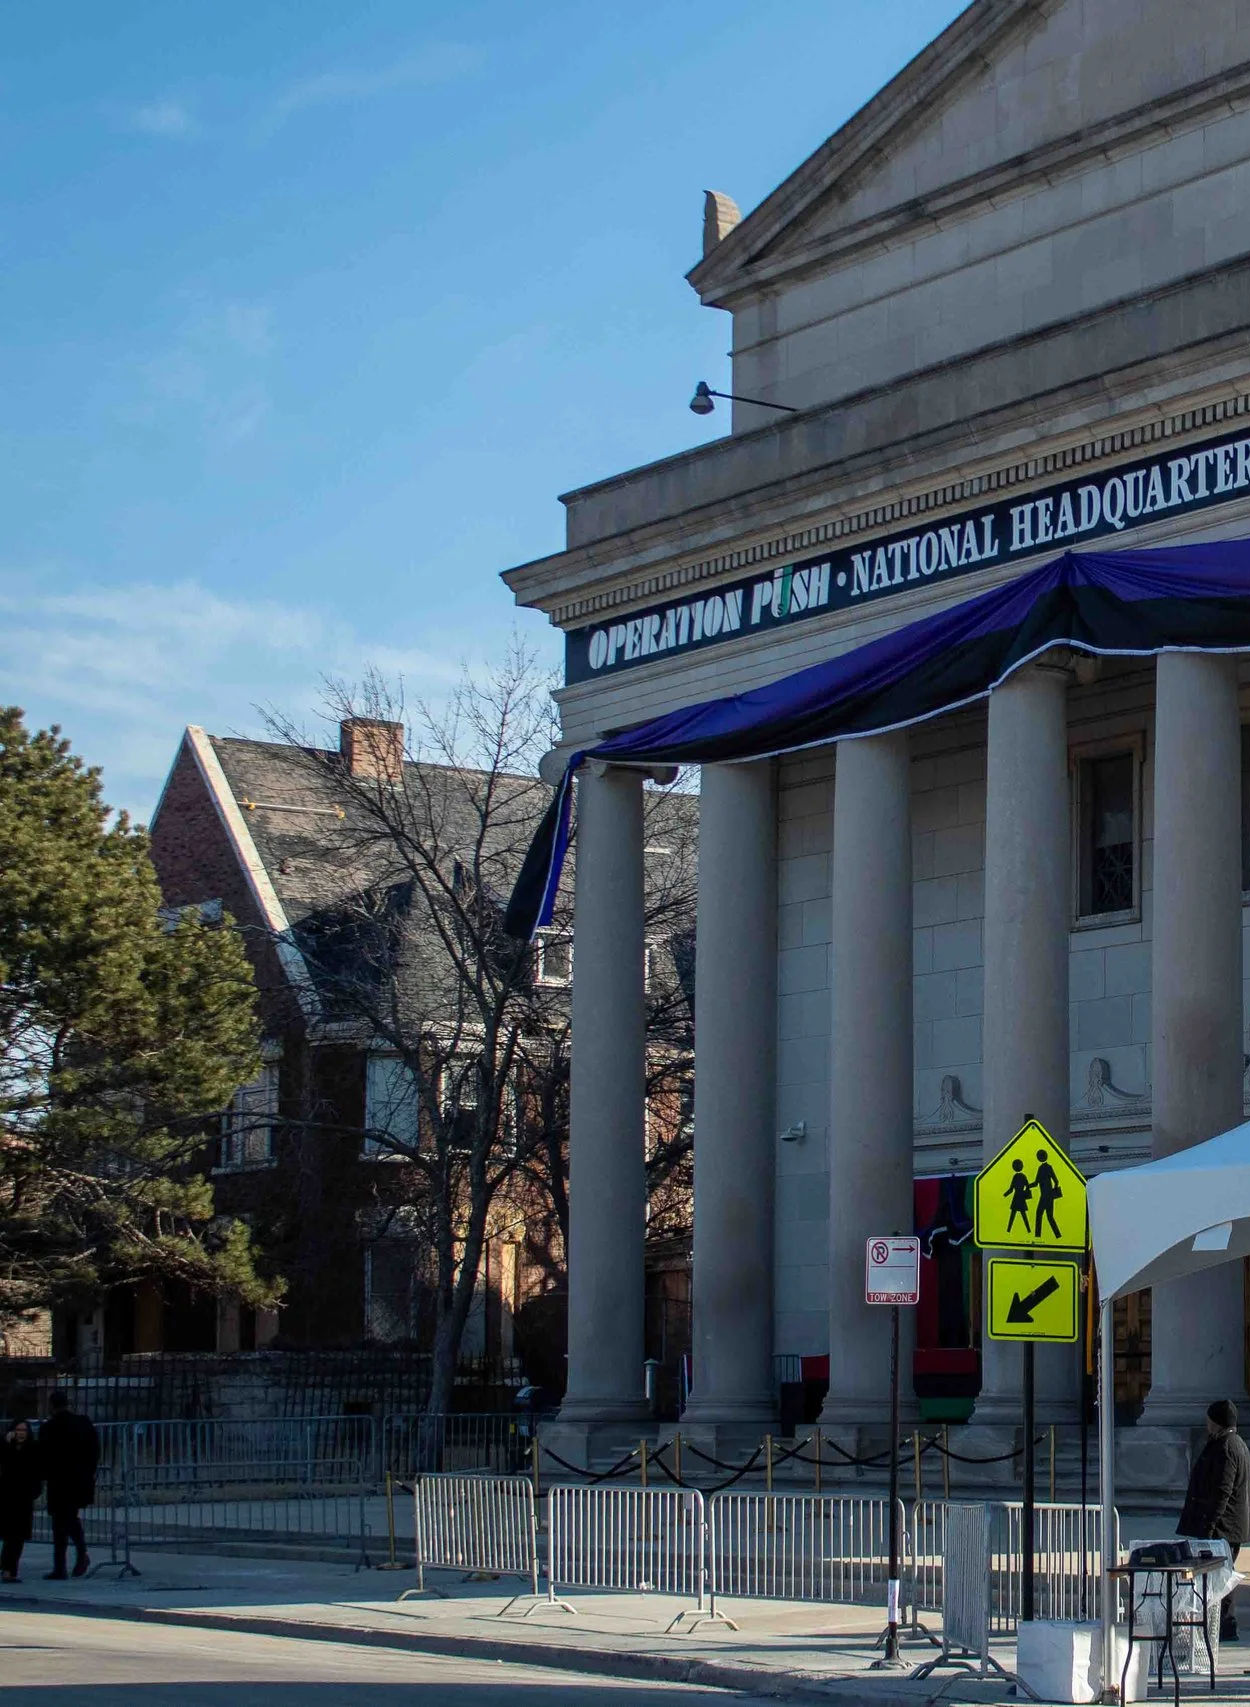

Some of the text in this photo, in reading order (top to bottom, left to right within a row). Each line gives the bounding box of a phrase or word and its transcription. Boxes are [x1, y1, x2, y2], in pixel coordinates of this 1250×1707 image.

[588, 589, 743, 670] OPERATION
[751, 562, 831, 625] PUSH
[850, 515, 999, 596] NATIONAL
[870, 1294, 913, 1302] TOW ZONE
